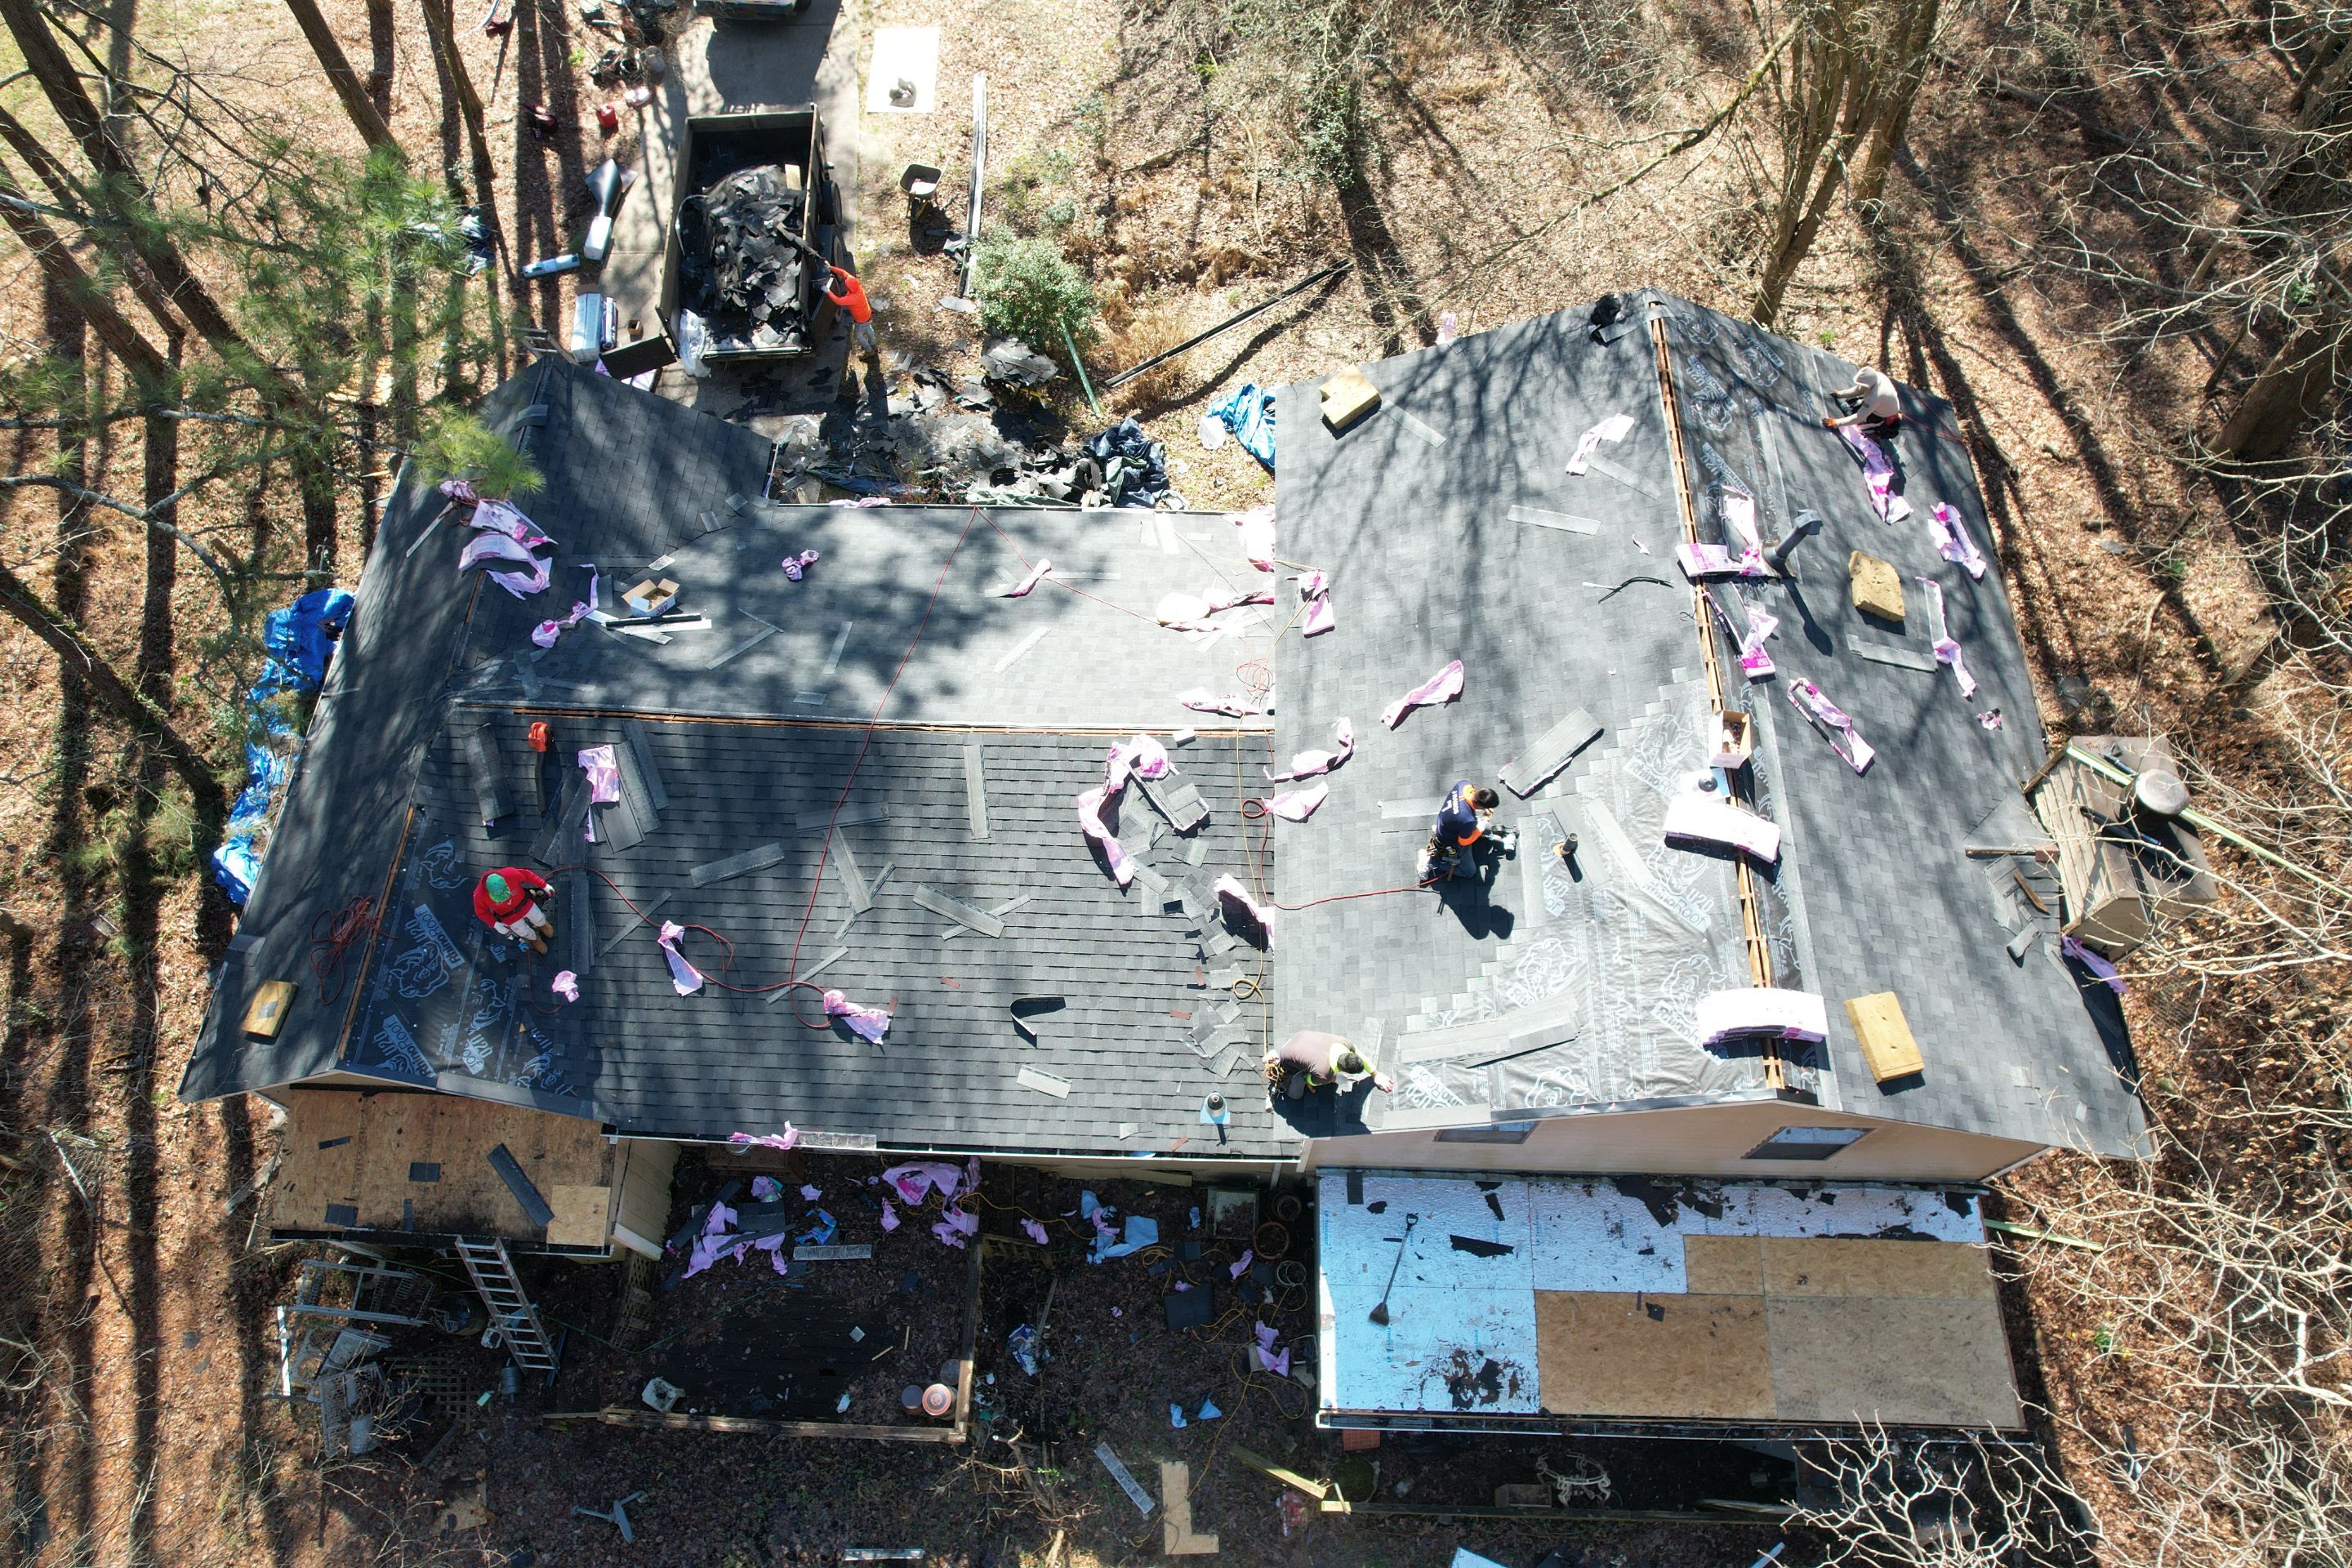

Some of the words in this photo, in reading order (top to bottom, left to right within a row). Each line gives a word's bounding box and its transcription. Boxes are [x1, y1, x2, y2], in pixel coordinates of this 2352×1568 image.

[1686, 367, 1705, 386] U20
[1543, 875, 1569, 897] U20
[1686, 888, 1714, 912] U20
[404, 919, 427, 942] U20
[416, 911, 461, 964] RhinoRoof
[373, 1031, 397, 1056] U20
[385, 1022, 431, 1076] RhinoRoof
[471, 1033, 493, 1058] U20
